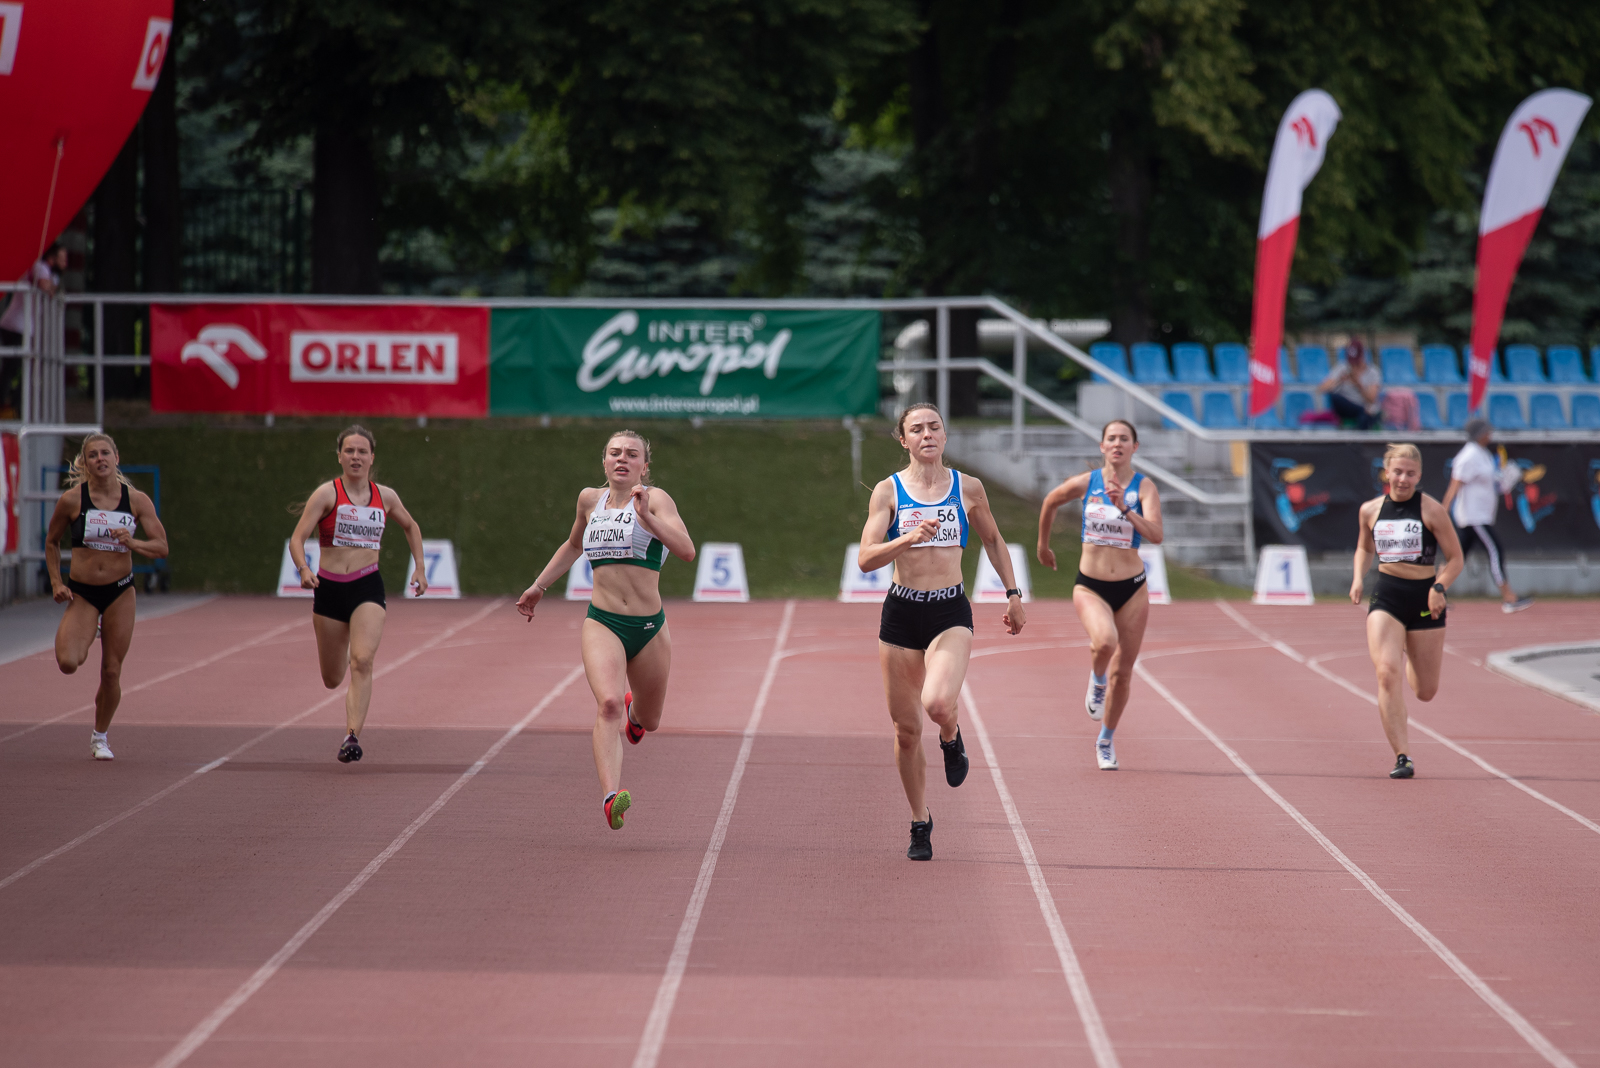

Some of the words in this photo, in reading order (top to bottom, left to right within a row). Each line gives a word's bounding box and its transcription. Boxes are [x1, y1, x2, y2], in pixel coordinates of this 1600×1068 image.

[301, 341, 446, 375] ORLEN
[576, 309, 792, 395] Europol
[119, 515, 133, 526] 47
[369, 510, 382, 522] 41
[614, 512, 633, 525] 43
[937, 508, 956, 523] 56
[337, 523, 382, 537] DZIEMIDOWICZ
[588, 528, 625, 543] MATUZNA
[1092, 521, 1123, 535] KANIA
[1404, 522, 1420, 534] 46
[1377, 538, 1420, 549] KWIATKOWSKA
[423, 552, 442, 585] 7
[711, 556, 732, 588] 5
[1280, 560, 1293, 590] 1
[891, 584, 926, 602] NIKE
[926, 585, 957, 602] PRO
